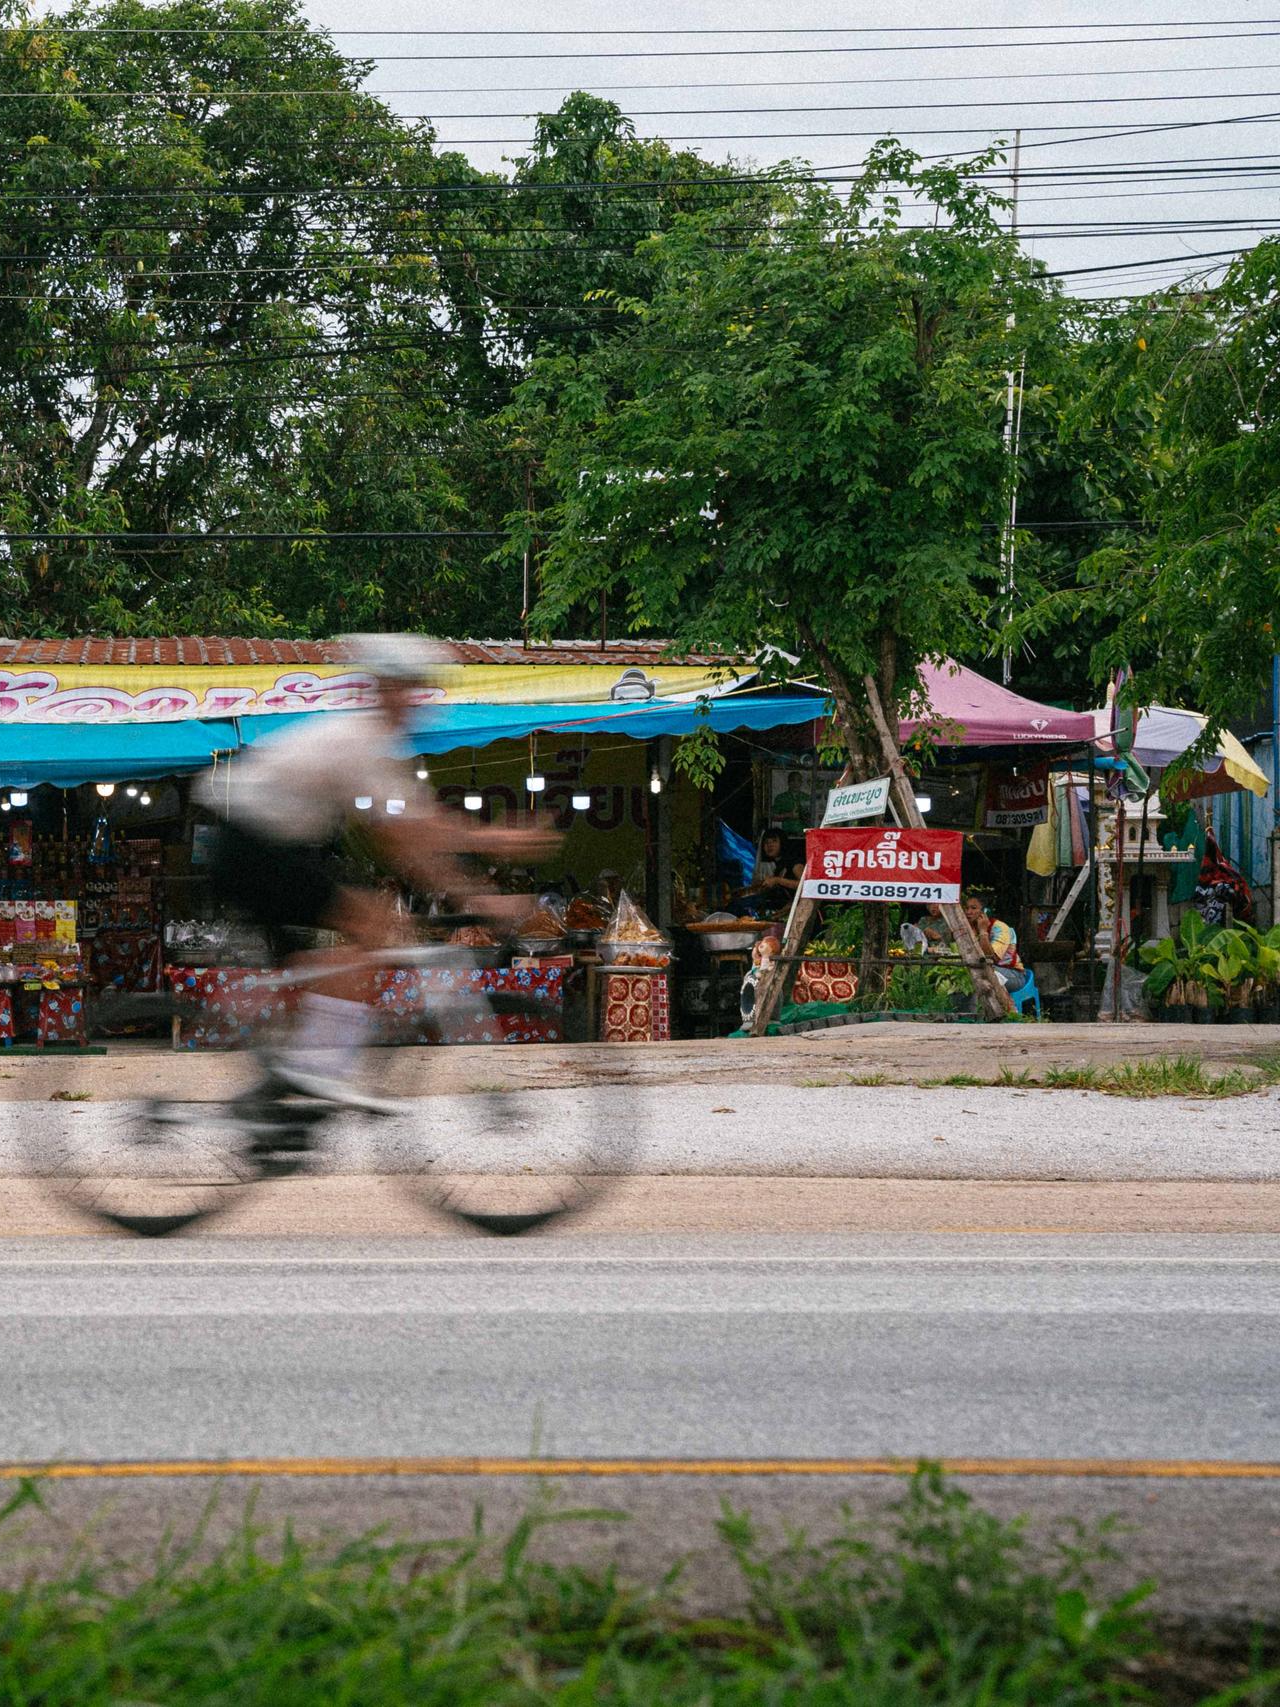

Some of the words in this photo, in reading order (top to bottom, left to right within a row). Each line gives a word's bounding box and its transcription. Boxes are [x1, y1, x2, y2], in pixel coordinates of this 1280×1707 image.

[832, 786, 883, 808] ต้นพะยูง
[823, 831, 942, 878] ลูกเจี๊ยบ
[817, 882, 943, 900] 087-3089741
